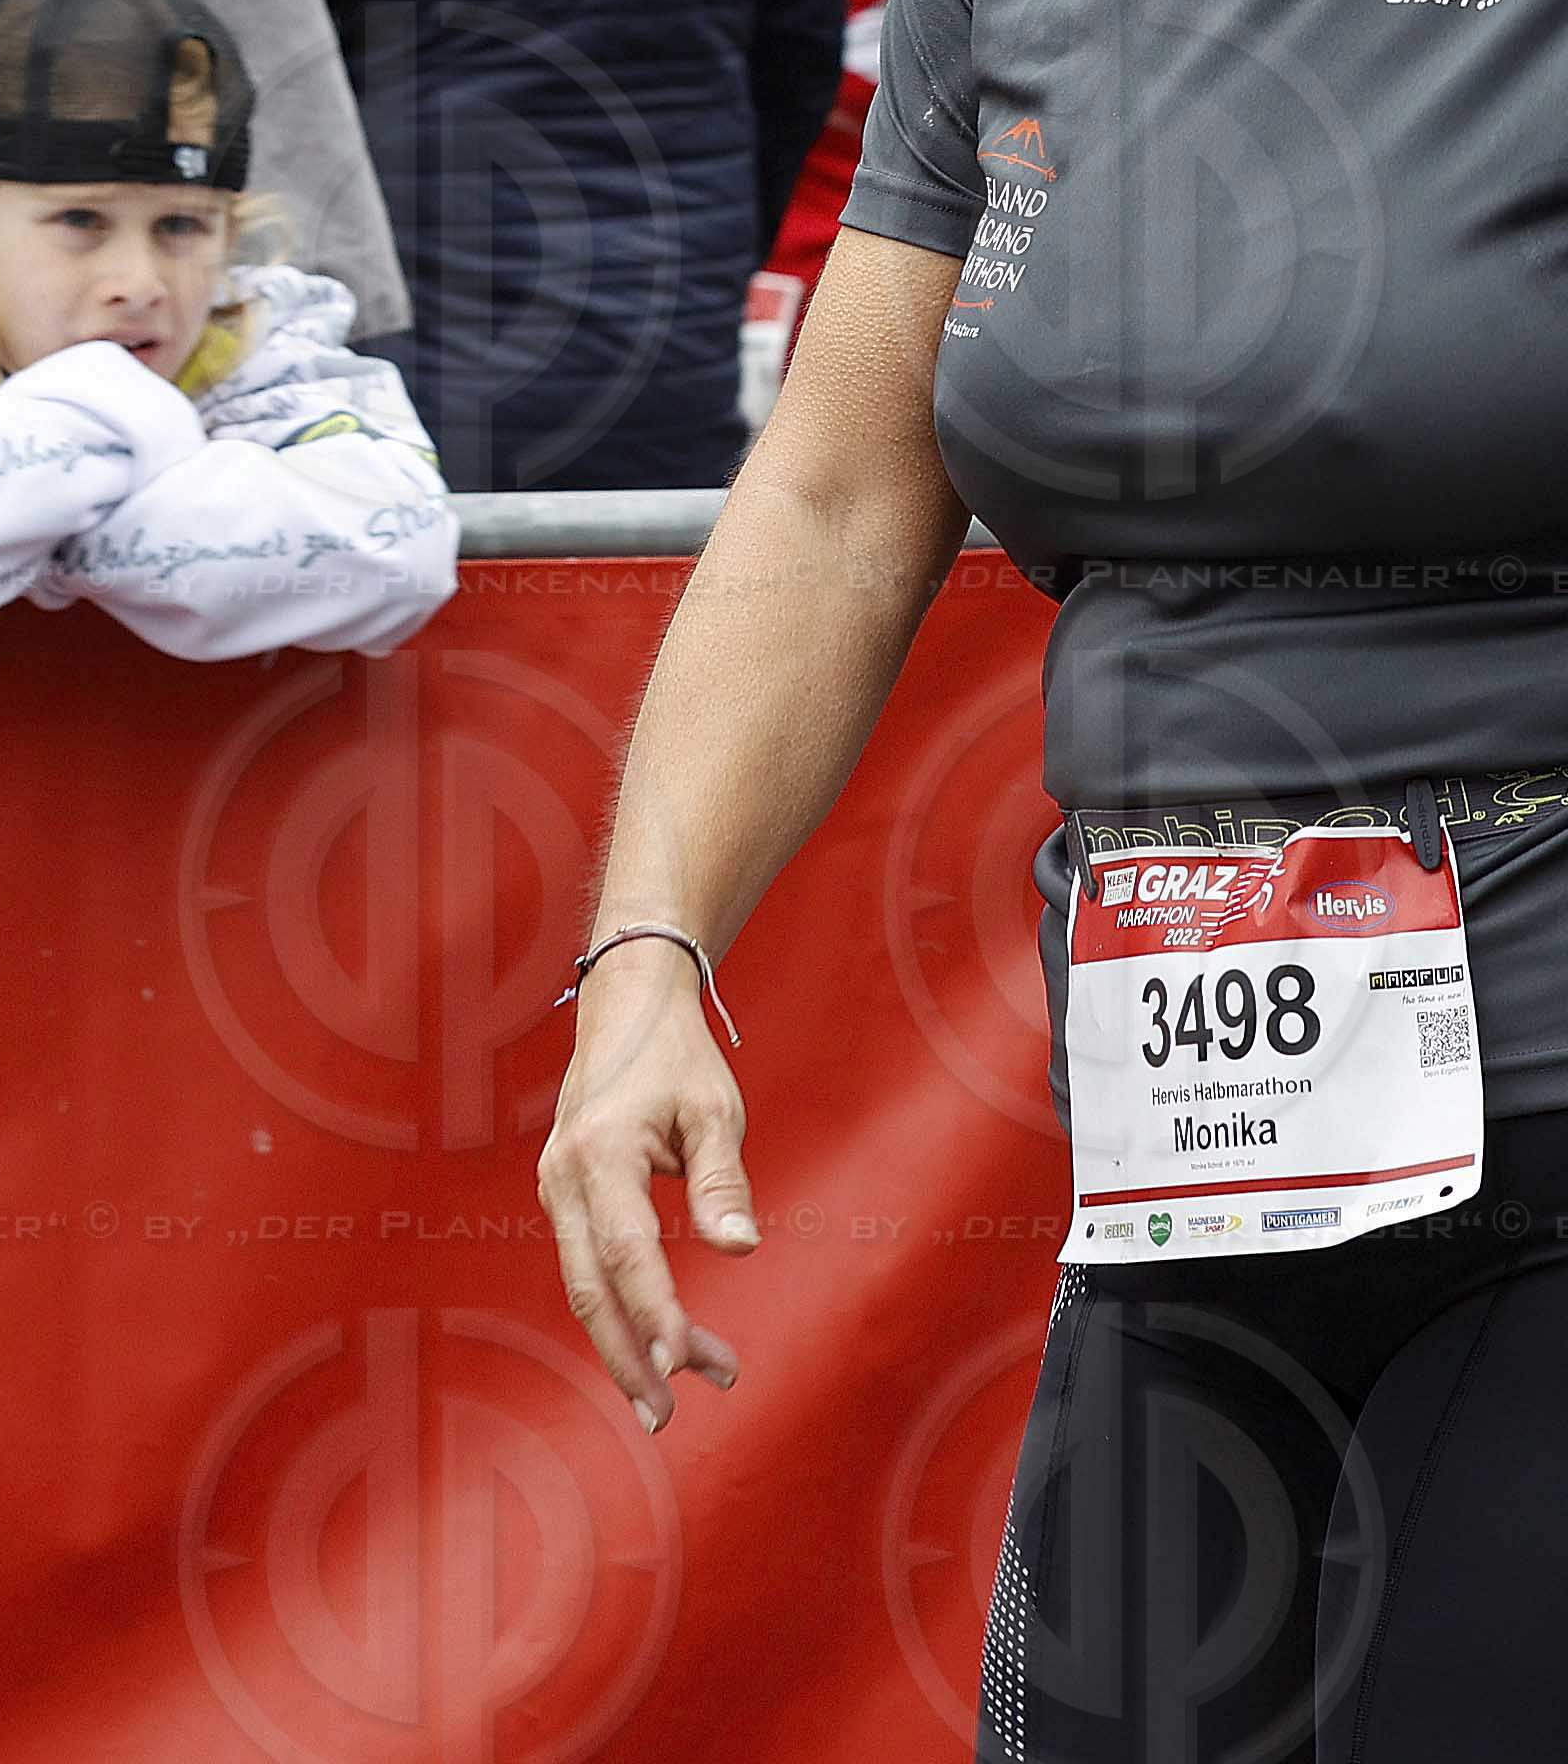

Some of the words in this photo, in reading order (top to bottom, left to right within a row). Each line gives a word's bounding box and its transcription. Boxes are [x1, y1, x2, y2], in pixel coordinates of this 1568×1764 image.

[1137, 865, 1239, 903] GRAZ
[1116, 906, 1196, 928] MARATHON
[1315, 892, 1387, 920] Hervis
[1163, 928, 1203, 947] 2022
[1142, 964, 1321, 1068] 3498
[1152, 1084, 1191, 1106] Hervis
[1194, 1076, 1312, 1102] Halbmarathon
[1174, 1111, 1278, 1153] Monika
[1264, 1211, 1336, 1229] PUNTIGAMER
